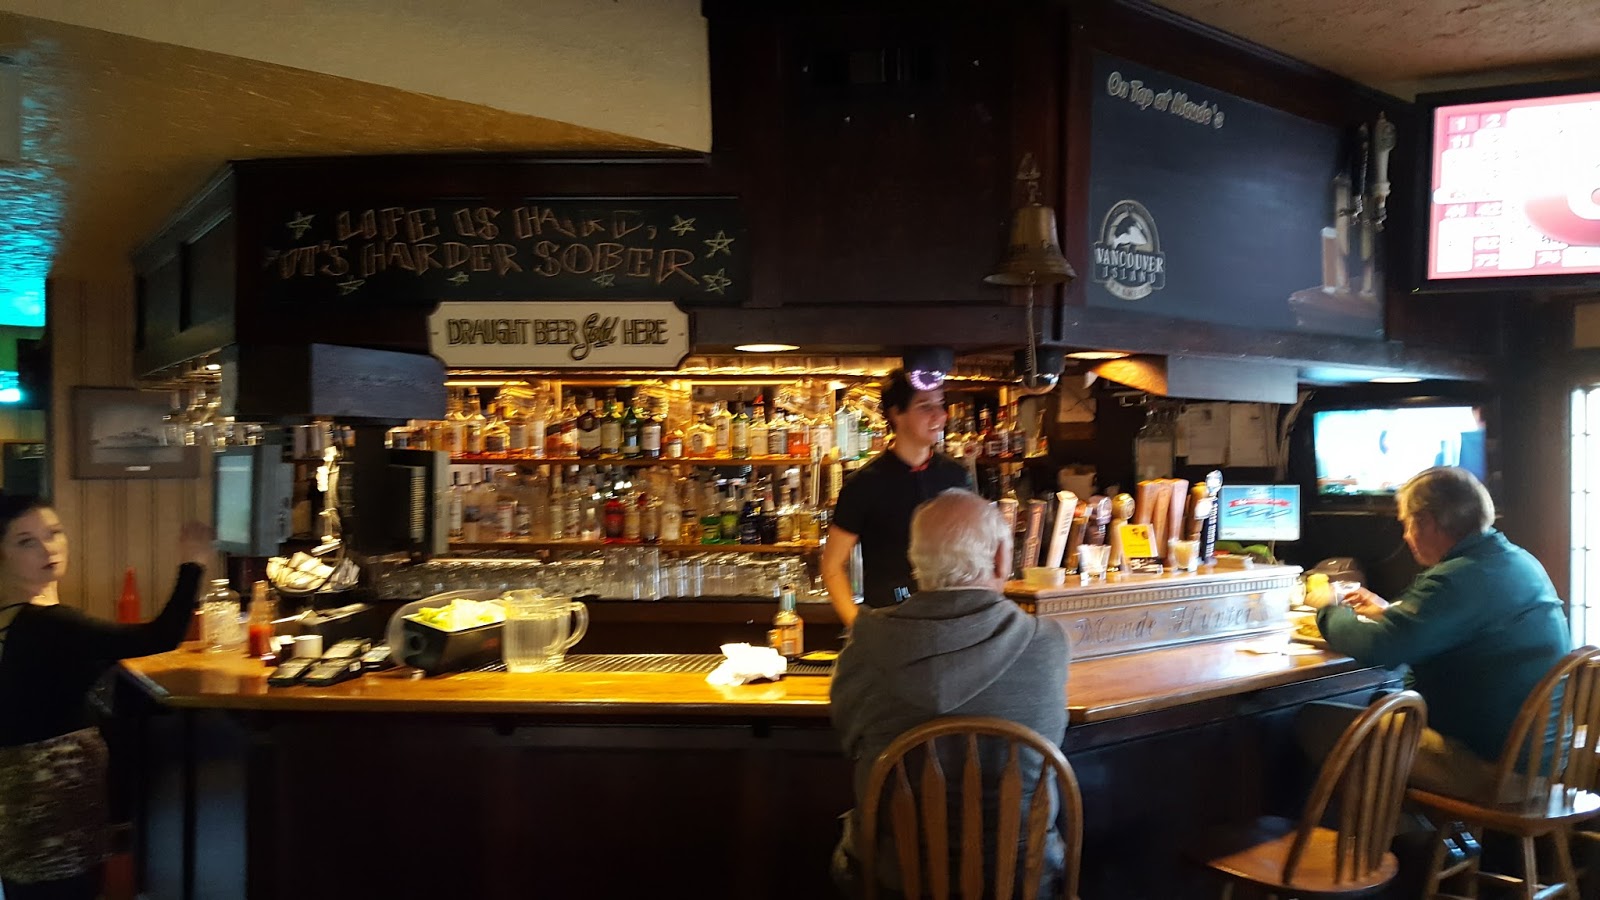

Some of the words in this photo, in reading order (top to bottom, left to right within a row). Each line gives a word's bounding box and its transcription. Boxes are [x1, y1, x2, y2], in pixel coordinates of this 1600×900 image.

[1107, 71, 1130, 99] On
[1129, 79, 1154, 111] Top
[1153, 88, 1173, 112] at
[335, 206, 441, 243] LIFE
[453, 206, 502, 241] IS
[359, 241, 524, 279] HARDER
[532, 239, 701, 286] SOBER
[1094, 247, 1164, 273] VANCOUVER
[1102, 265, 1156, 284] ISLAND
[447, 318, 531, 346] DRAUGHT
[533, 318, 579, 346] BEER
[569, 312, 621, 361] Sold
[622, 318, 670, 346] HERE
